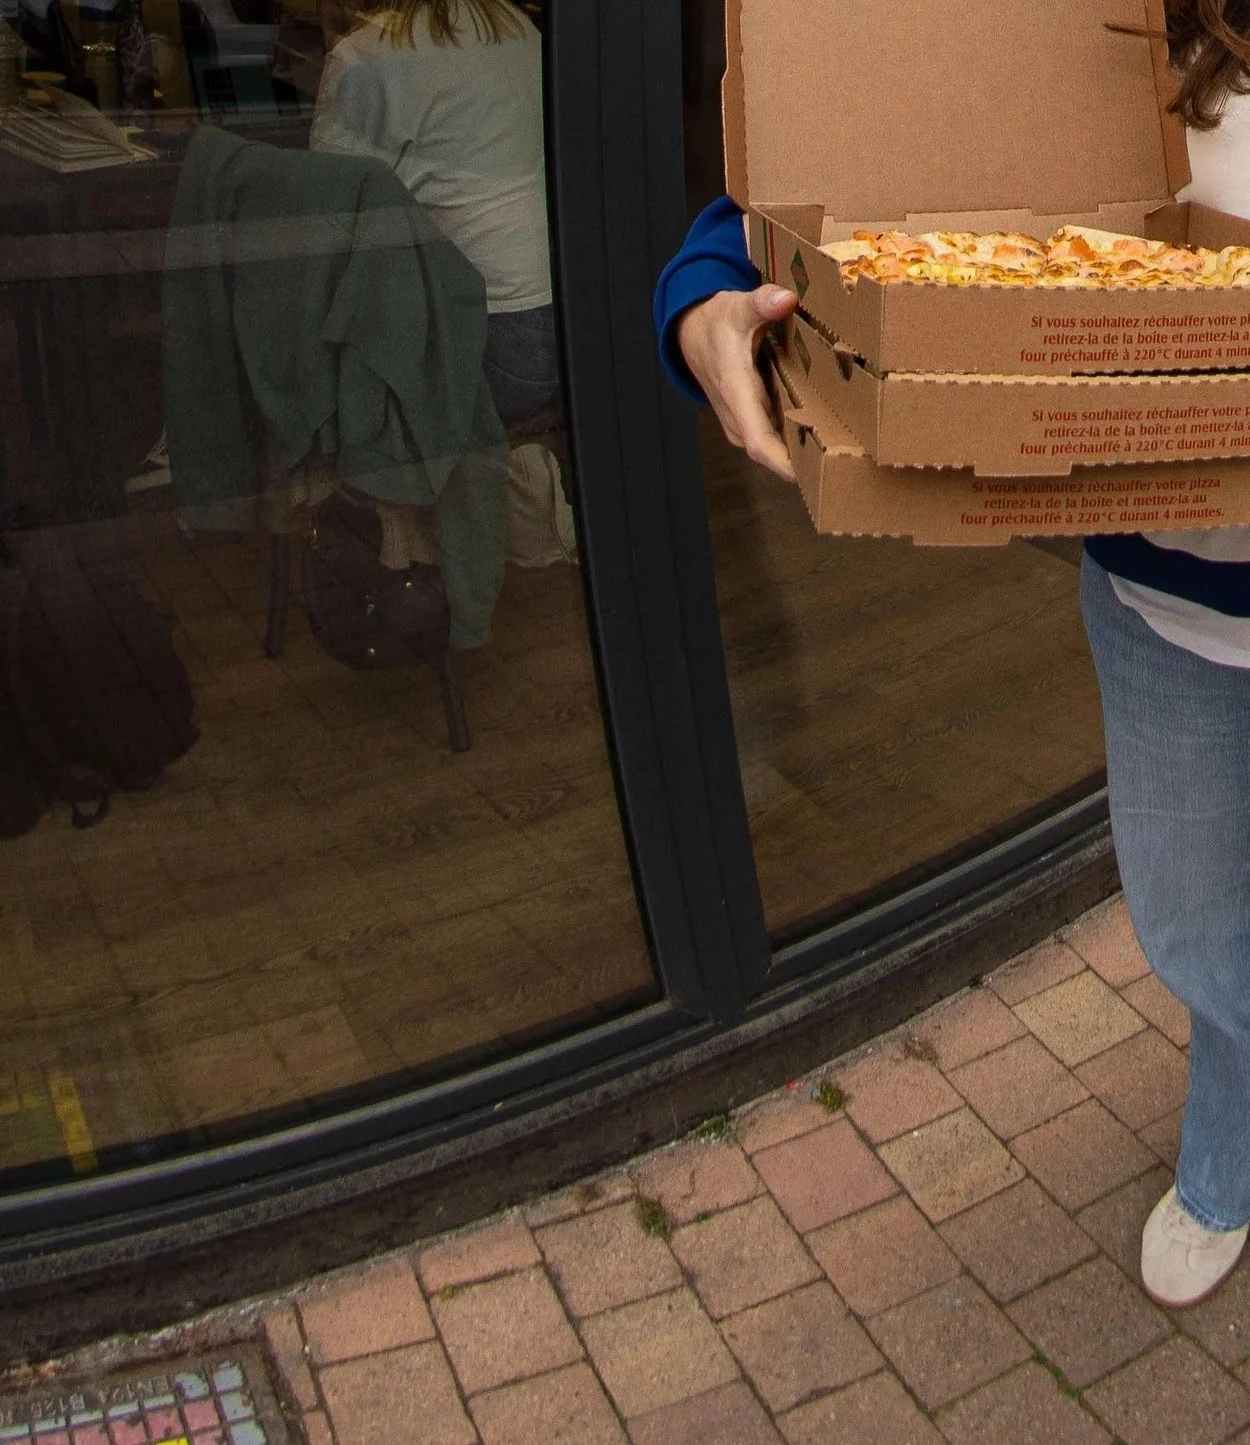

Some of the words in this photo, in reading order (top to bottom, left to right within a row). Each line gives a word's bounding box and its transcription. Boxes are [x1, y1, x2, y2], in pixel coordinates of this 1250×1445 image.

[1031, 315, 1042, 327] Si
[1046, 316, 1077, 327] vous
[1080, 315, 1141, 327] souhaitez
[1144, 313, 1206, 327] réchauffer
[1208, 315, 1237, 326] votre
[1044, 332, 1100, 345] retirez-la
[1103, 331, 1119, 344] de
[1123, 331, 1134, 344] la
[1172, 332, 1183, 343] et
[1187, 330, 1240, 343] mettez-la
[1019, 350, 1047, 362] four
[1051, 348, 1119, 364] préchauffé
[1123, 348, 1131, 360] à
[1135, 348, 1171, 360] 220°C
[1174, 347, 1212, 359] durant
[1216, 346, 1223, 357] 4
[1032, 410, 1043, 421] Si
[1048, 411, 1078, 421] vous
[1082, 408, 1144, 421] souhaitez
[1147, 406, 1210, 419] réchauffer
[1212, 406, 1243, 417] votre
[1044, 425, 1101, 438] retirez-la
[1105, 425, 1121, 436] de
[1125, 424, 1136, 436] la
[1175, 423, 1187, 434] et
[1190, 420, 1245, 434] mettez-la
[1019, 442, 1047, 455] four
[1051, 440, 1122, 456] préchauffé
[1125, 440, 1132, 452] à
[1137, 440, 1173, 452] 220°C
[1177, 438, 1215, 451] durant
[1220, 437, 1227, 448] 4
[972, 482, 983, 493] Si
[988, 482, 1018, 493] vous
[1021, 481, 1085, 493] souhaitez
[1088, 479, 1152, 492] réchauffer
[1155, 478, 1186, 490] votre
[1190, 477, 1221, 490] pizza
[984, 497, 1042, 509] retirez-la
[1046, 497, 1062, 509] de
[1067, 497, 1078, 509] la
[1117, 496, 1129, 507] et
[1133, 493, 1189, 506] mettez-la
[1192, 493, 1208, 503] au
[960, 513, 988, 526] four
[991, 512, 1062, 526] préchauffé
[1066, 512, 1074, 523] à
[1078, 512, 1114, 523] 220°C
[1119, 511, 1158, 522] durant
[1163, 509, 1170, 520] 4
[1174, 507, 1225, 520] minutes.
